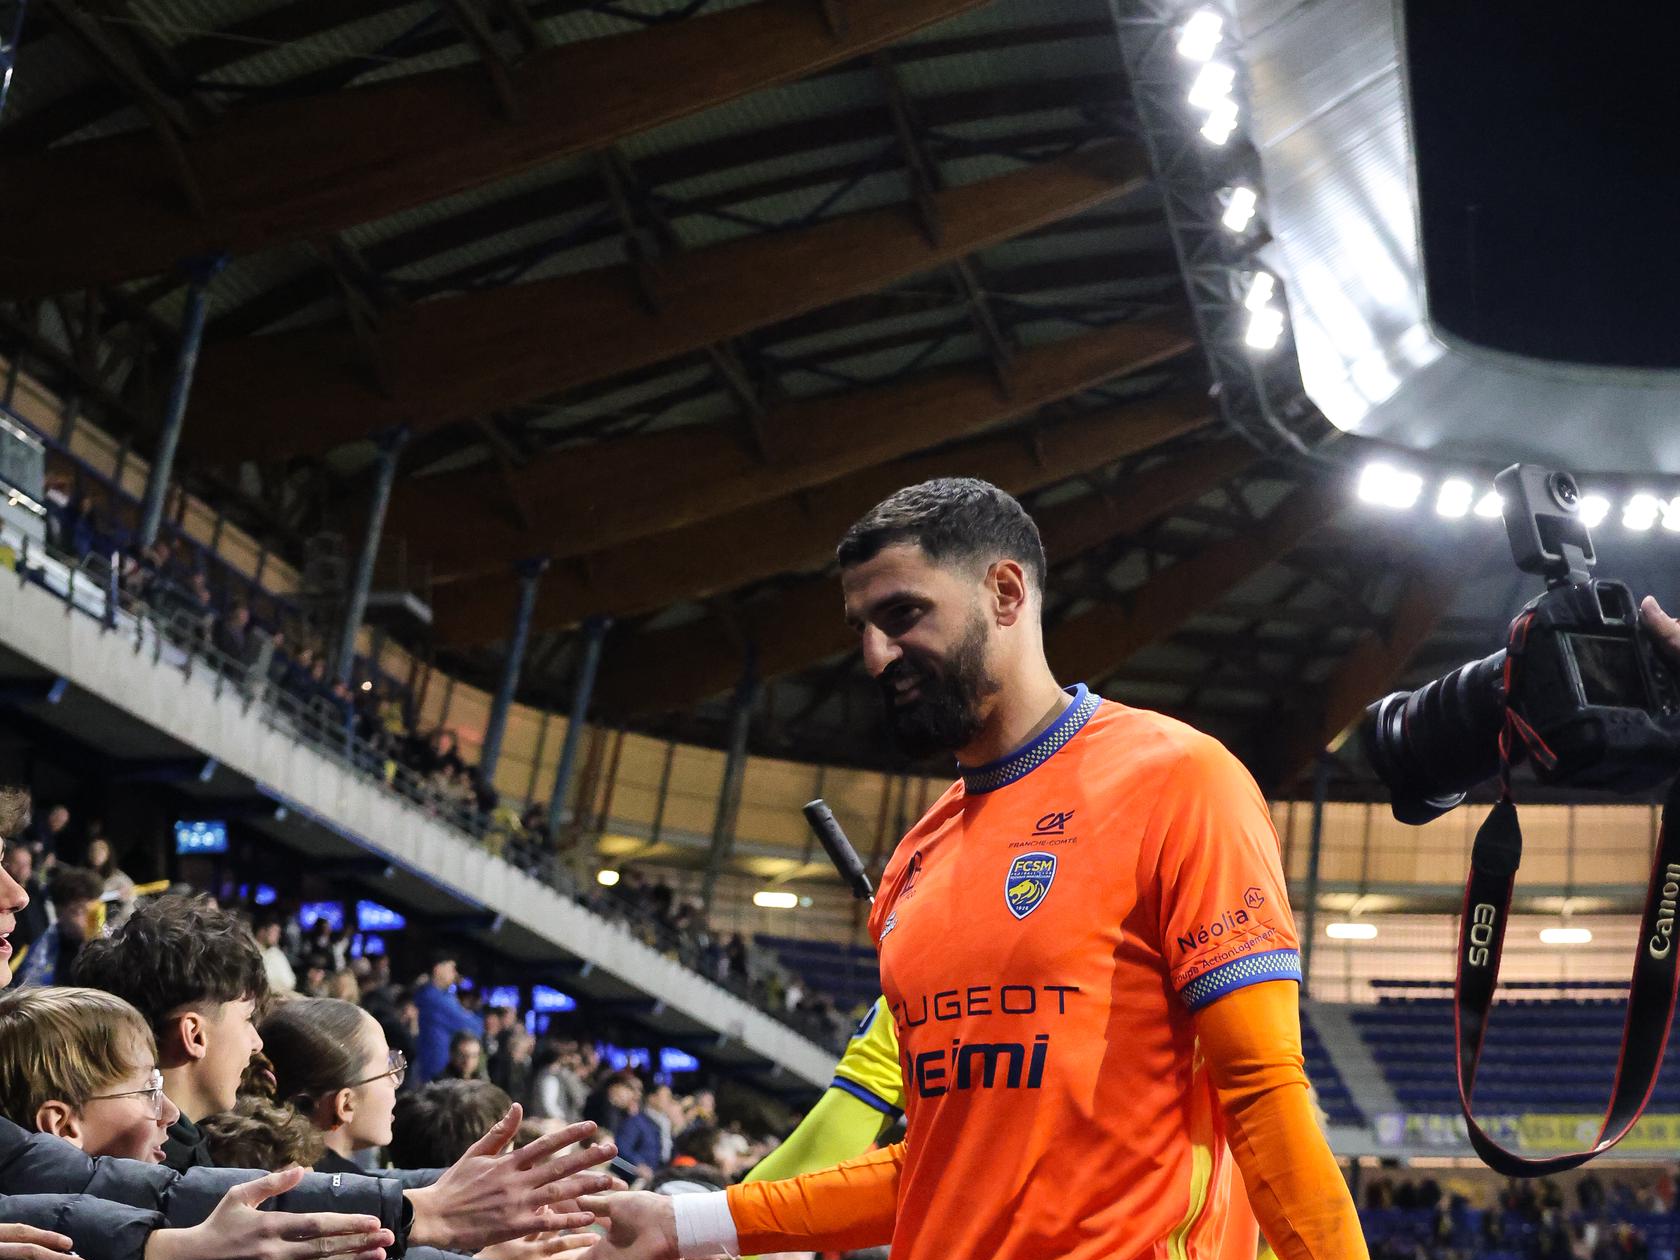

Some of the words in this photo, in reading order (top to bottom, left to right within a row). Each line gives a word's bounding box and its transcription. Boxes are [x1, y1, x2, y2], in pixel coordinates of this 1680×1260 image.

[1014, 860, 1053, 873] FCSM
[1177, 909, 1249, 954] Néolia
[1469, 903, 1496, 967] EOS
[1650, 863, 1680, 960] Canon
